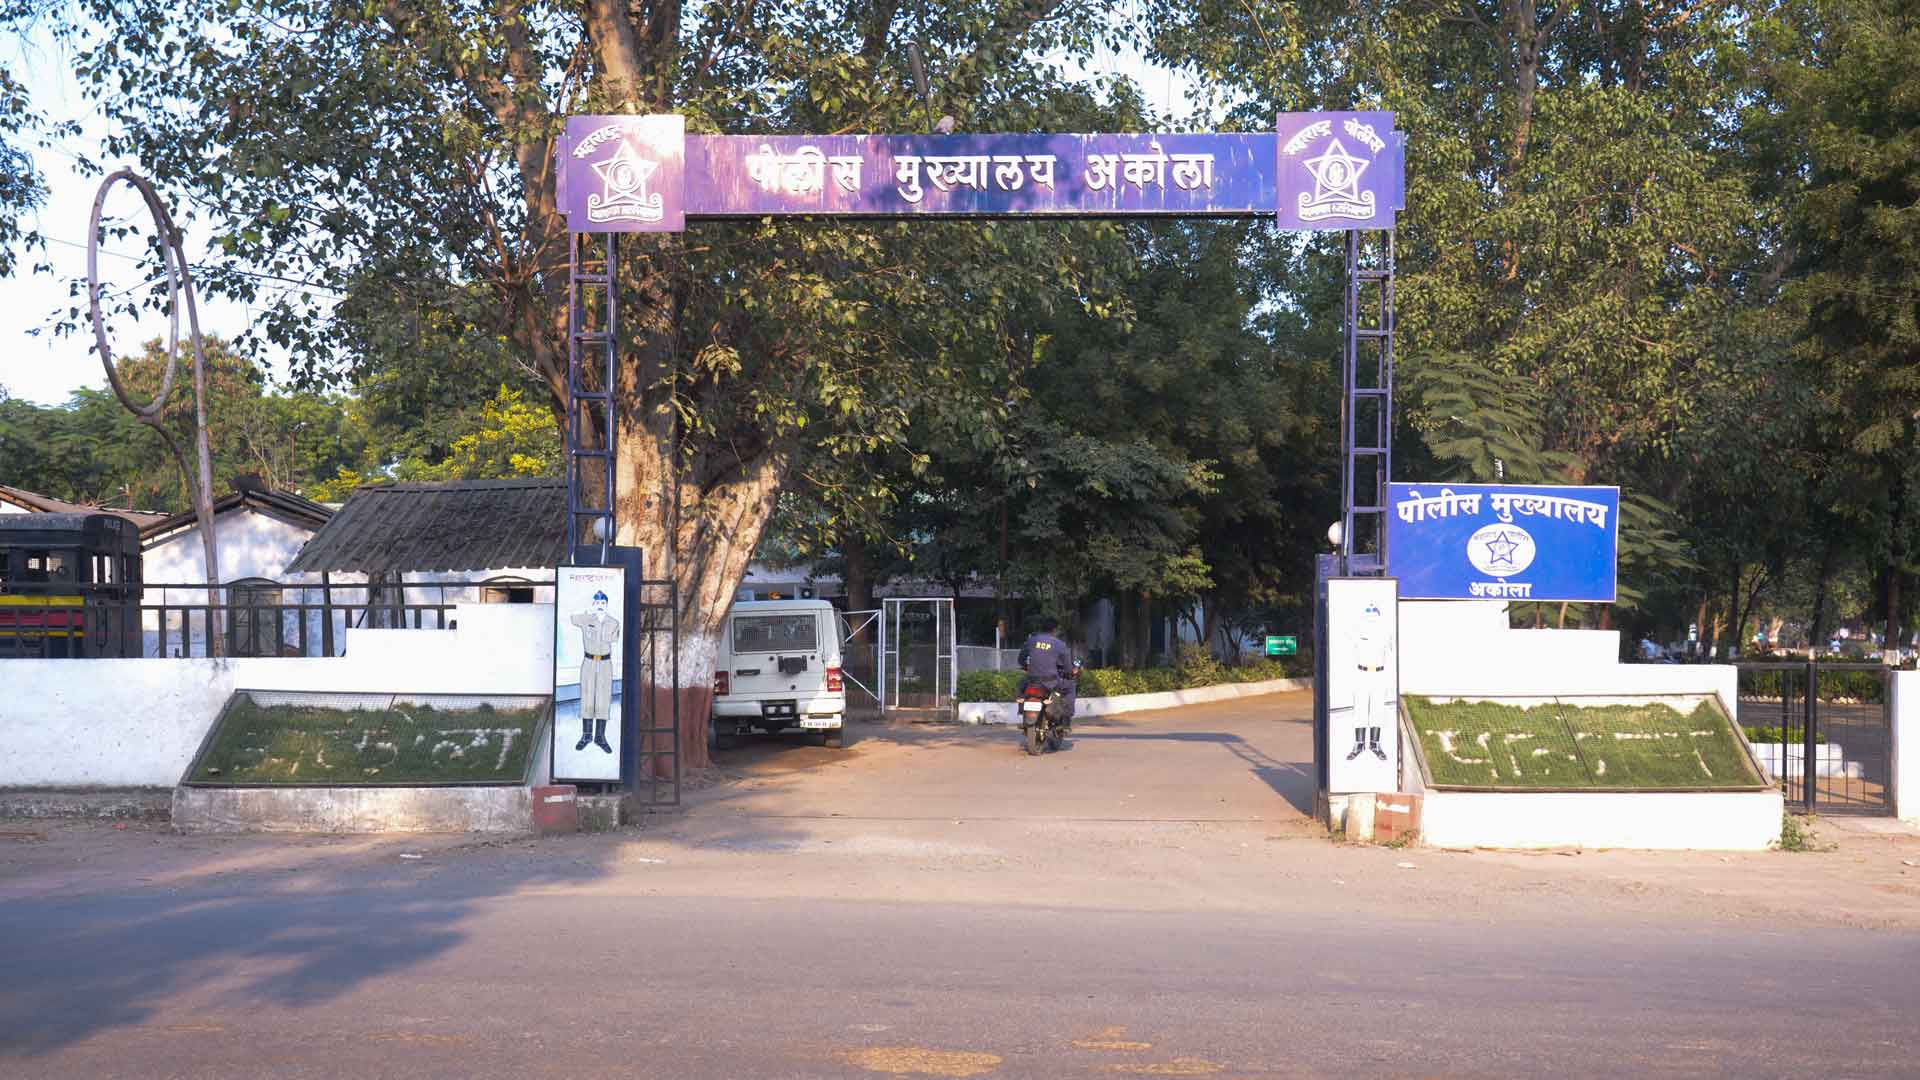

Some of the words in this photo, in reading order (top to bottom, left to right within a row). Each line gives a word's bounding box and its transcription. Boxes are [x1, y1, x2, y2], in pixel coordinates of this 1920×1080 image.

[745, 144, 864, 193] पोलीस
[894, 153, 1057, 204] मुख्यालय
[1085, 142, 1215, 192] अकोला
[1397, 488, 1483, 524] पोलीस
[1490, 493, 1609, 528] मुख्यालय
[1468, 578, 1533, 597] अकोला
